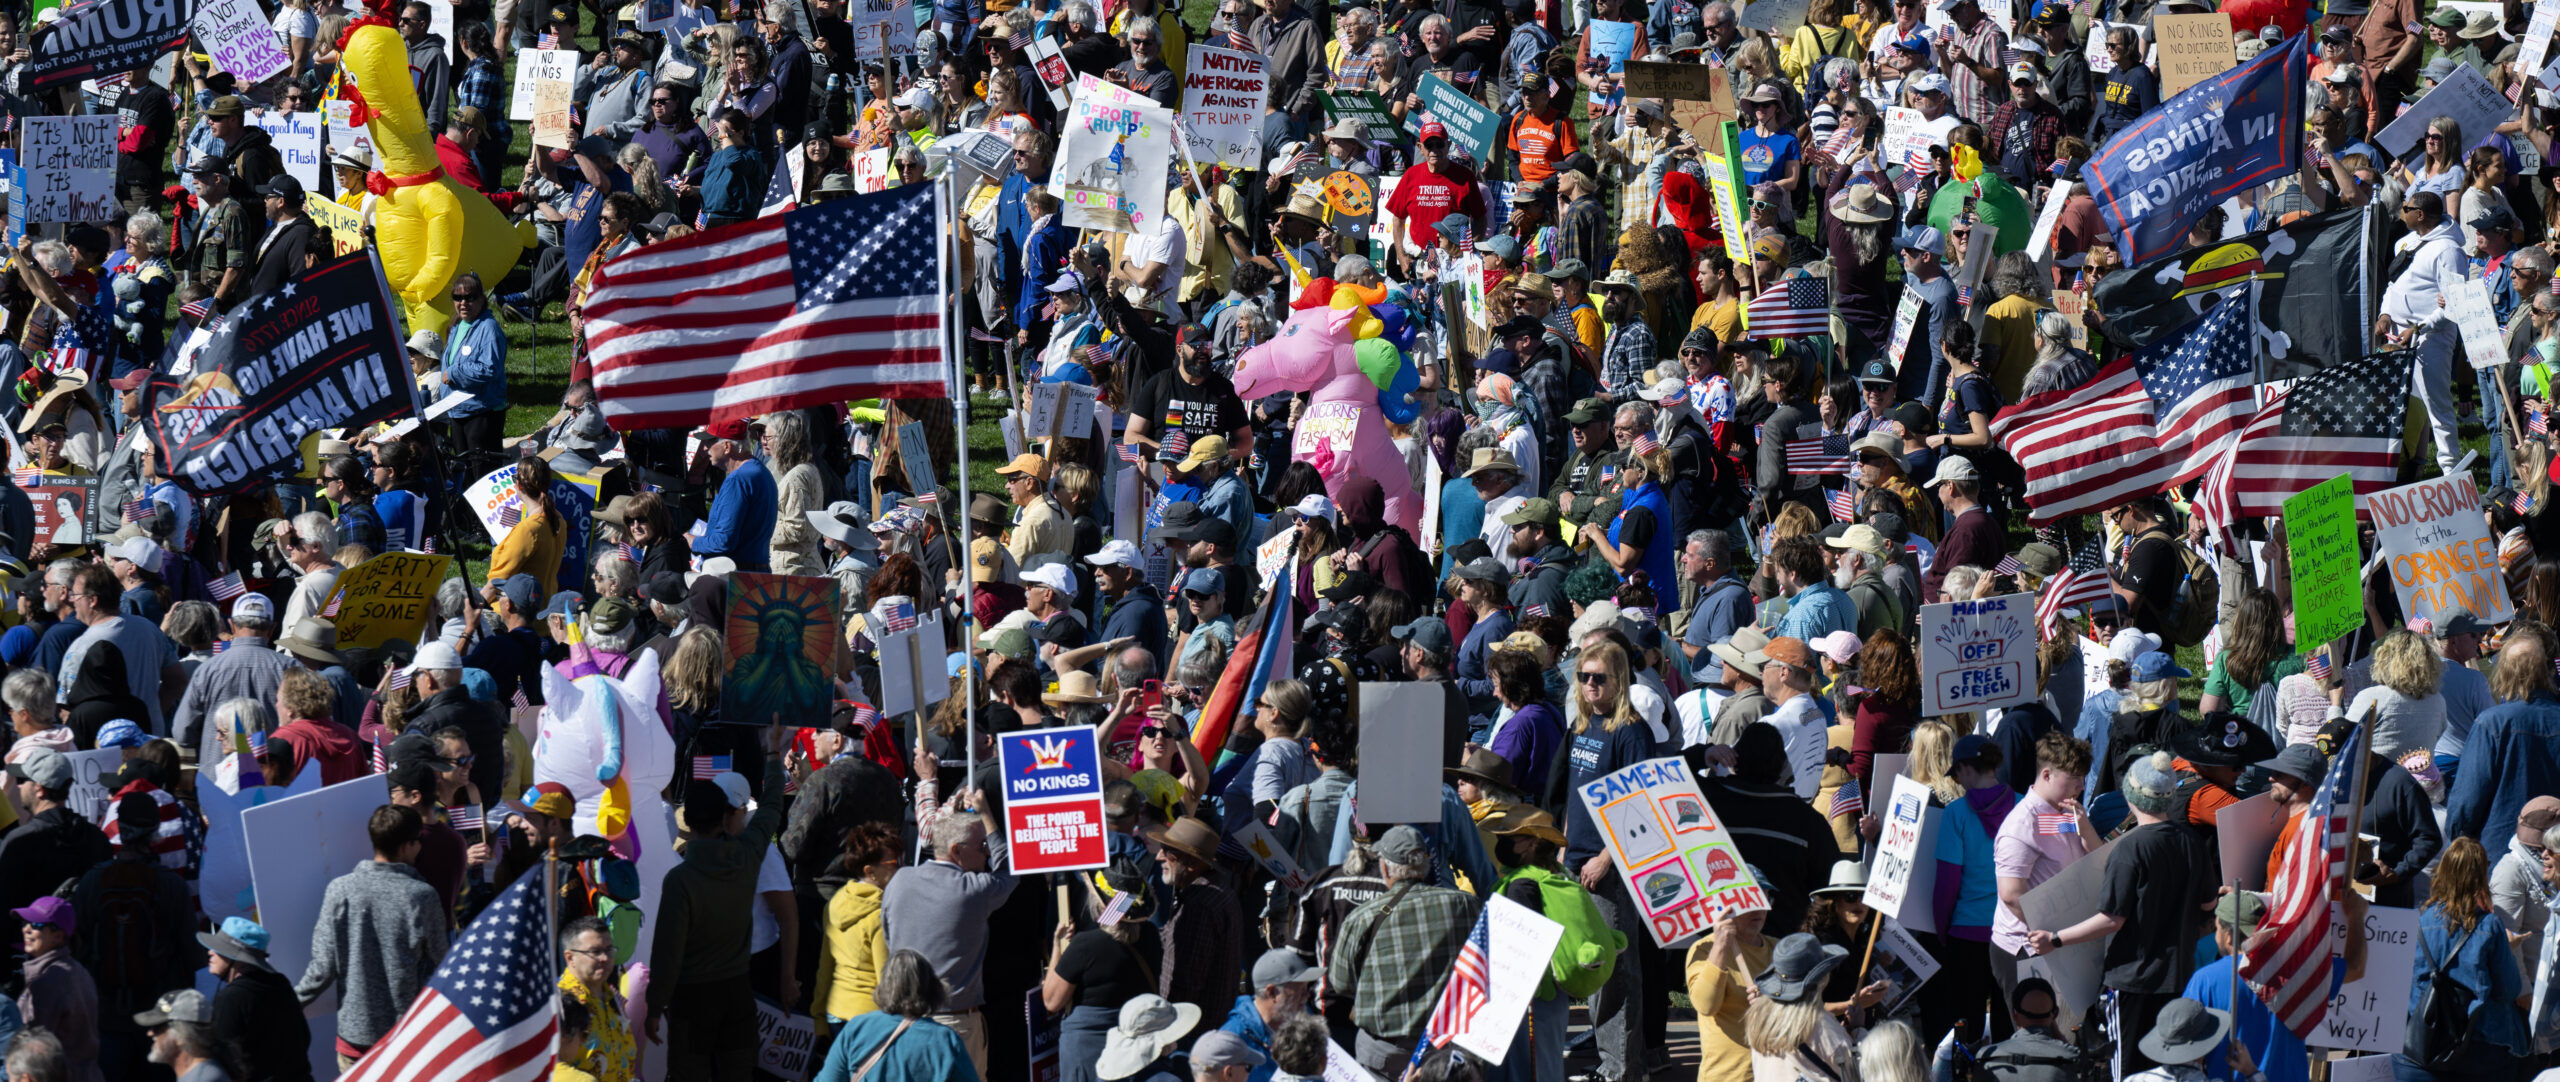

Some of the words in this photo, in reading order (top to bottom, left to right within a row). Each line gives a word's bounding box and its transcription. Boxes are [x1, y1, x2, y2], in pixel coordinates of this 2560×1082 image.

[210, 2, 239, 28] NOT
[214, 11, 256, 47] REFORM!
[857, 22, 904, 40] STOP
[2167, 24, 2184, 39] NO
[2189, 22, 2224, 39] KINGS
[213, 44, 239, 67] NO
[240, 25, 274, 52] KING
[246, 40, 278, 67] KKK
[888, 43, 916, 55] NOW
[2170, 43, 2184, 55] NO
[2187, 42, 2230, 56] DICTATORS
[541, 52, 554, 64] NO
[1202, 52, 1263, 74] NATIVE
[2175, 61, 2189, 74] NO
[2193, 60, 2226, 74] FELONS
[528, 67, 562, 79] KINGS
[1184, 73, 1264, 92] AMERICANS
[1082, 78, 1131, 105] DEPORT
[1633, 80, 1694, 92] VETERANS
[2479, 82, 2496, 99] NOT
[1201, 93, 1259, 110] AGAINST
[1432, 84, 1472, 115] EQUALITY
[1467, 105, 1486, 125] AND
[1191, 112, 1252, 126] TRUMP
[1432, 100, 1457, 121] LOVE
[1452, 113, 1474, 133] OVER
[29, 121, 63, 147] It's
[71, 121, 110, 146] NOT
[292, 119, 315, 141] King
[34, 148, 71, 171] Left
[287, 148, 317, 166] Flush
[857, 155, 873, 178] IT'S
[44, 172, 71, 193] It's
[866, 174, 887, 193] TIME
[1418, 185, 1450, 196] TRUMP:
[1064, 190, 1144, 224] CONGRESS
[1416, 194, 1433, 202] Make
[1417, 200, 1434, 208] Afraid
[1434, 200, 1449, 208] Again
[57, 205, 67, 219] vs
[308, 196, 330, 225] Smells
[332, 212, 358, 233] Like
[2057, 295, 2082, 315] Hate
[1037, 387, 1056, 400] The
[1186, 401, 1202, 411] YOU
[1203, 403, 1219, 413] ARE
[1303, 402, 1358, 421] UNICORNS
[1184, 411, 1219, 428] SAFE
[1304, 417, 1351, 434] AGAINST
[1184, 426, 1204, 434] WITH
[51, 478, 78, 486] KINGS
[488, 465, 518, 484] THE
[2285, 503, 2292, 523] I
[2313, 487, 2330, 512] Hate
[2367, 492, 2411, 531] NO
[2406, 474, 2481, 524] CROWN
[2310, 537, 2318, 550] A
[2415, 526, 2434, 547] for
[2431, 524, 2459, 542] the
[2311, 557, 2322, 570] An
[2392, 536, 2496, 588] ORANGE
[338, 556, 442, 591] LIBERTY
[349, 580, 382, 599] FOR
[385, 580, 425, 598] ALL
[2306, 583, 2350, 614] BOOMER
[359, 602, 420, 620] SOME
[2295, 621, 2305, 647] I
[1963, 643, 1997, 660] OFF
[1961, 666, 2004, 686] FREE
[1949, 679, 2011, 700] SPEECH
[1575, 735, 1588, 745] ONE
[1587, 737, 1604, 750] VOICE
[1570, 747, 1600, 765] CHANGE
[1013, 778, 1037, 793] NO
[1039, 773, 1091, 791] KINGS
[1586, 763, 1659, 808] SAME
[1653, 759, 1685, 786] ACT
[1025, 813, 1047, 828] THE
[1046, 810, 1086, 827] POWER
[1014, 826, 1063, 844] BELONGS
[1062, 825, 1078, 841] TO
[1078, 822, 1100, 838] THE
[1887, 822, 1915, 852] DUMP
[1039, 838, 1078, 855] PEOPLE
[1876, 850, 1910, 885] TRUMP
[1652, 894, 1718, 944] DIFF
[1723, 886, 1765, 913] HAT
[2363, 914, 2409, 945] Since
[1890, 929, 1907, 948] FUCK
[1903, 943, 1919, 959] THIS
[1915, 954, 1929, 969] GUY
[2362, 990, 2378, 1012] It
[774, 1024, 814, 1051] KING
[2328, 1015, 2381, 1047] Way!
[780, 1047, 808, 1073] NO
